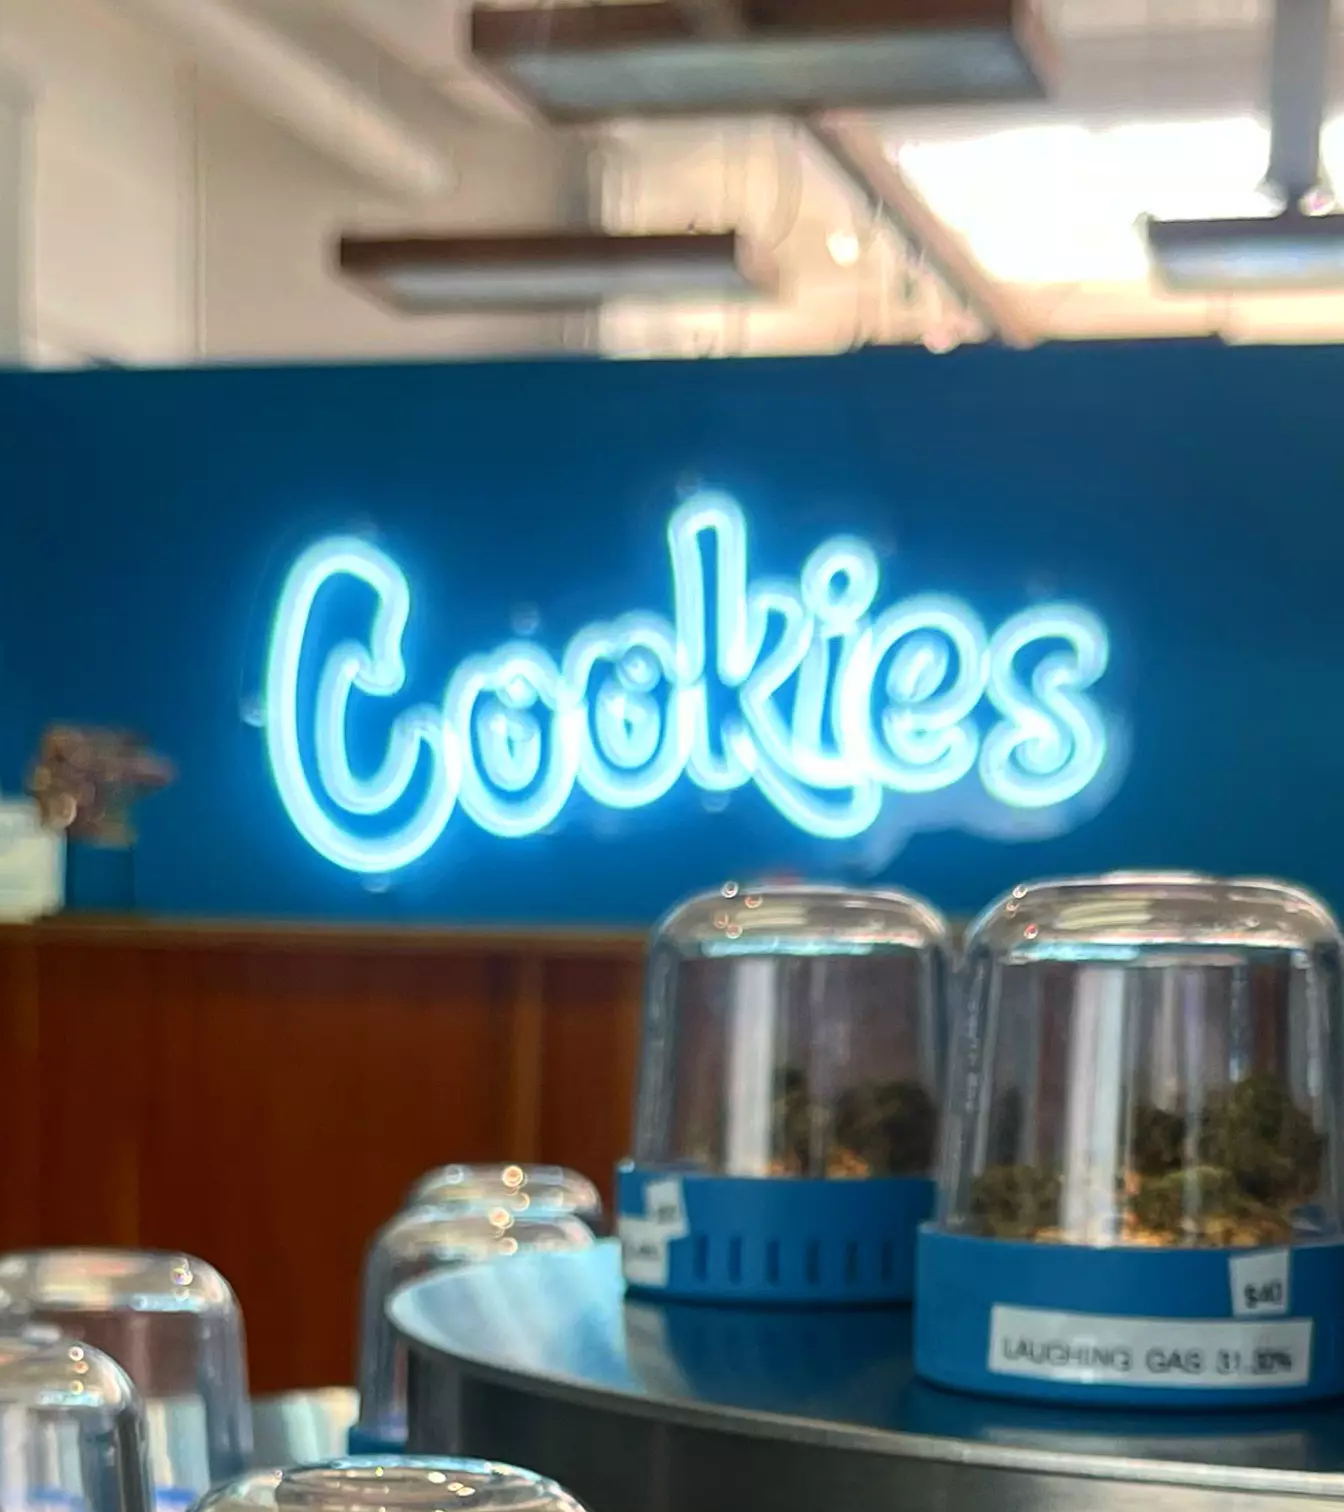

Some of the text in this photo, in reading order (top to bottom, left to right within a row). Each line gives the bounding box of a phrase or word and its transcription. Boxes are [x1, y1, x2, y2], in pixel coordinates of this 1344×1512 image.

[262, 488, 1114, 875] Cookies
[1001, 1336, 1133, 1372] LAUGHING
[1145, 1347, 1204, 1376] GAS
